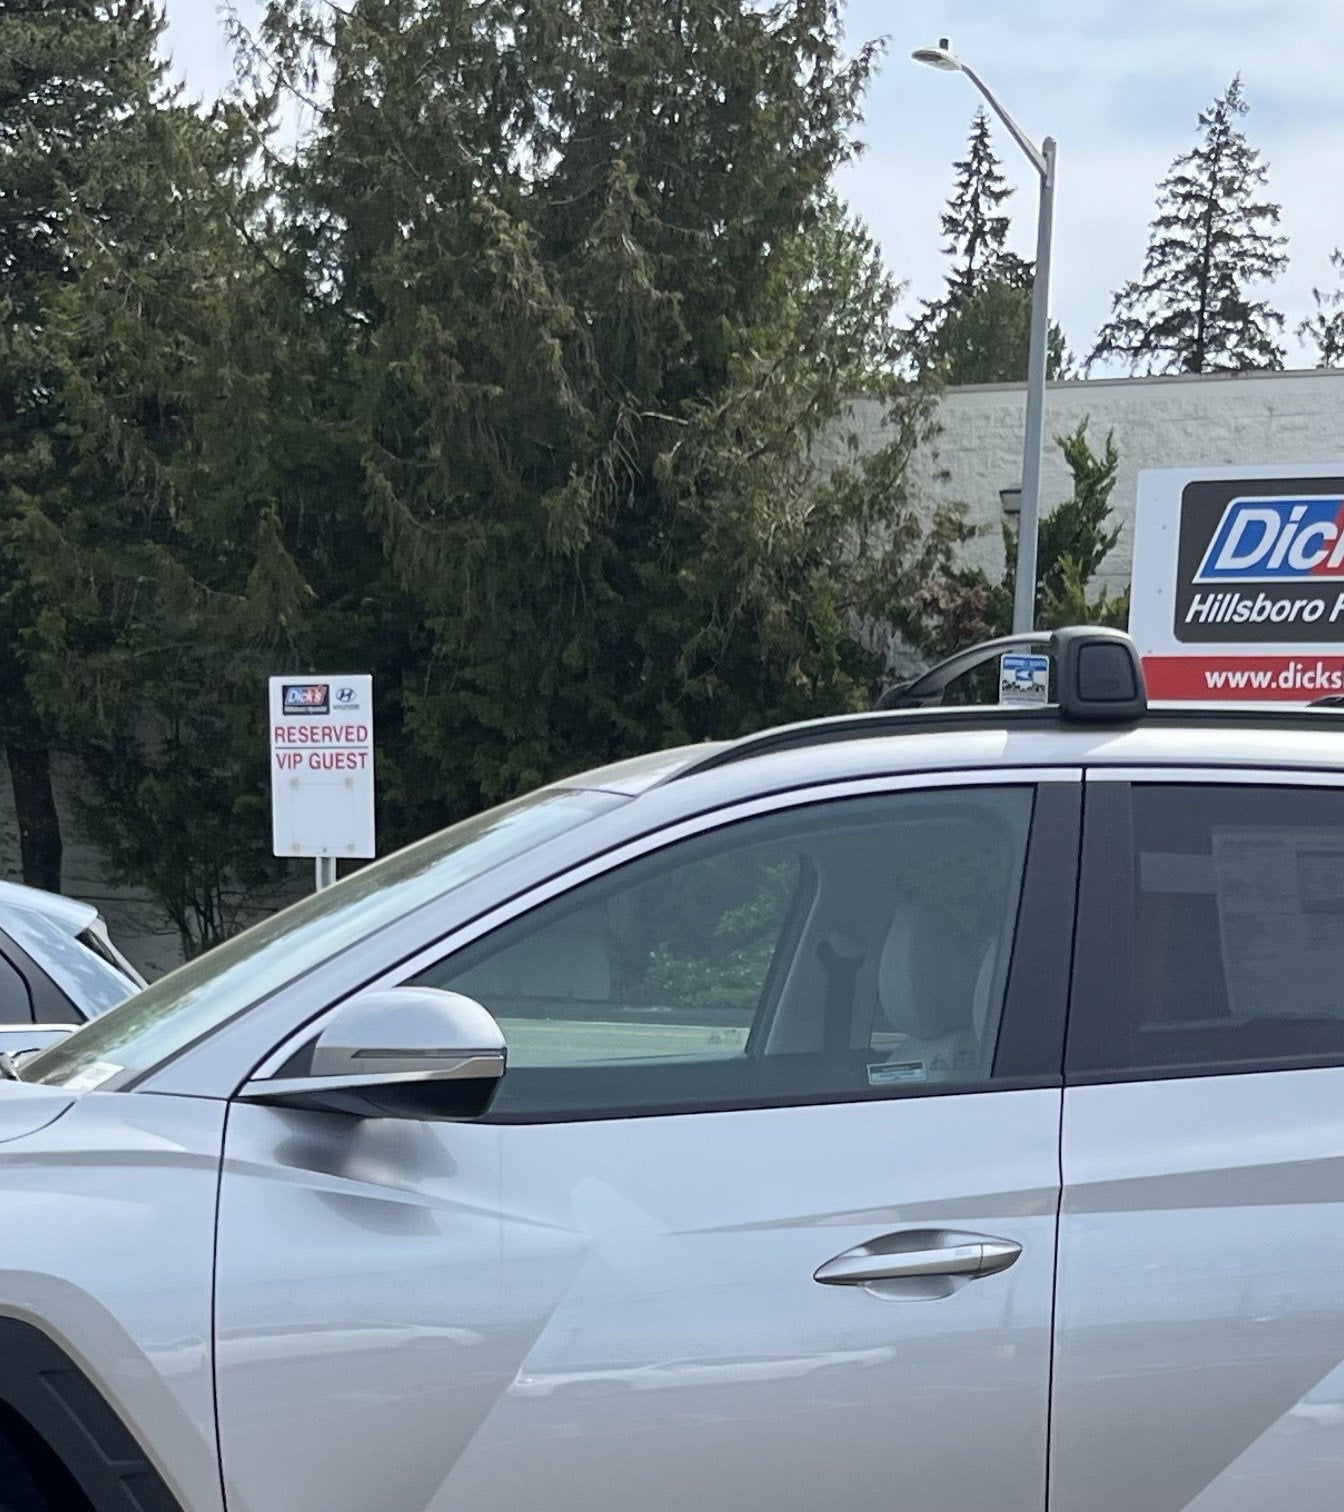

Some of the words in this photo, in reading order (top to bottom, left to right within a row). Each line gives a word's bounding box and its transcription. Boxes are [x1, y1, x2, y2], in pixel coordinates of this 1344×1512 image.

[1184, 592, 1325, 623] Hillsboro
[274, 724, 368, 743] RESERVED
[275, 753, 303, 770] VIP
[308, 751, 369, 771] GUEST
